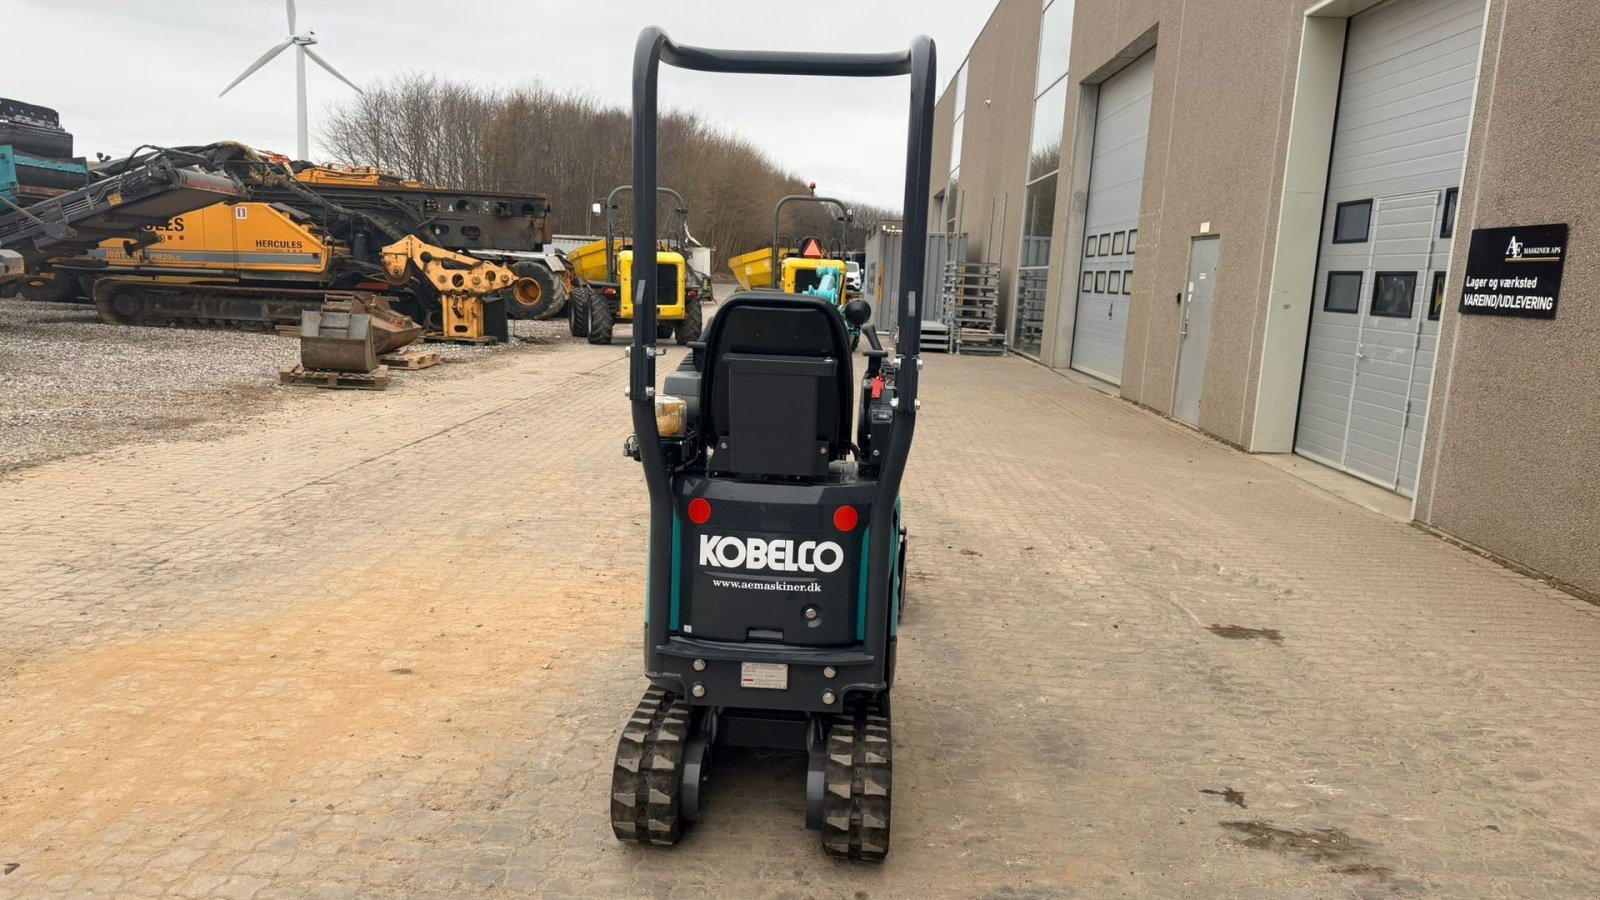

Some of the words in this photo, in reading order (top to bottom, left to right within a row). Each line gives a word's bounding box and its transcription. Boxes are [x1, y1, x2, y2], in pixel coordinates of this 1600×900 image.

[255, 239, 303, 249] HERCULES
[1466, 276, 1487, 290] Lager
[1489, 279, 1498, 290] og
[1500, 276, 1537, 288] værksted
[1464, 294, 1553, 310] VAREIND/UDLEVERING
[699, 534, 844, 573] KOBELCO
[712, 579, 822, 592] www.aemaskiner.dk
